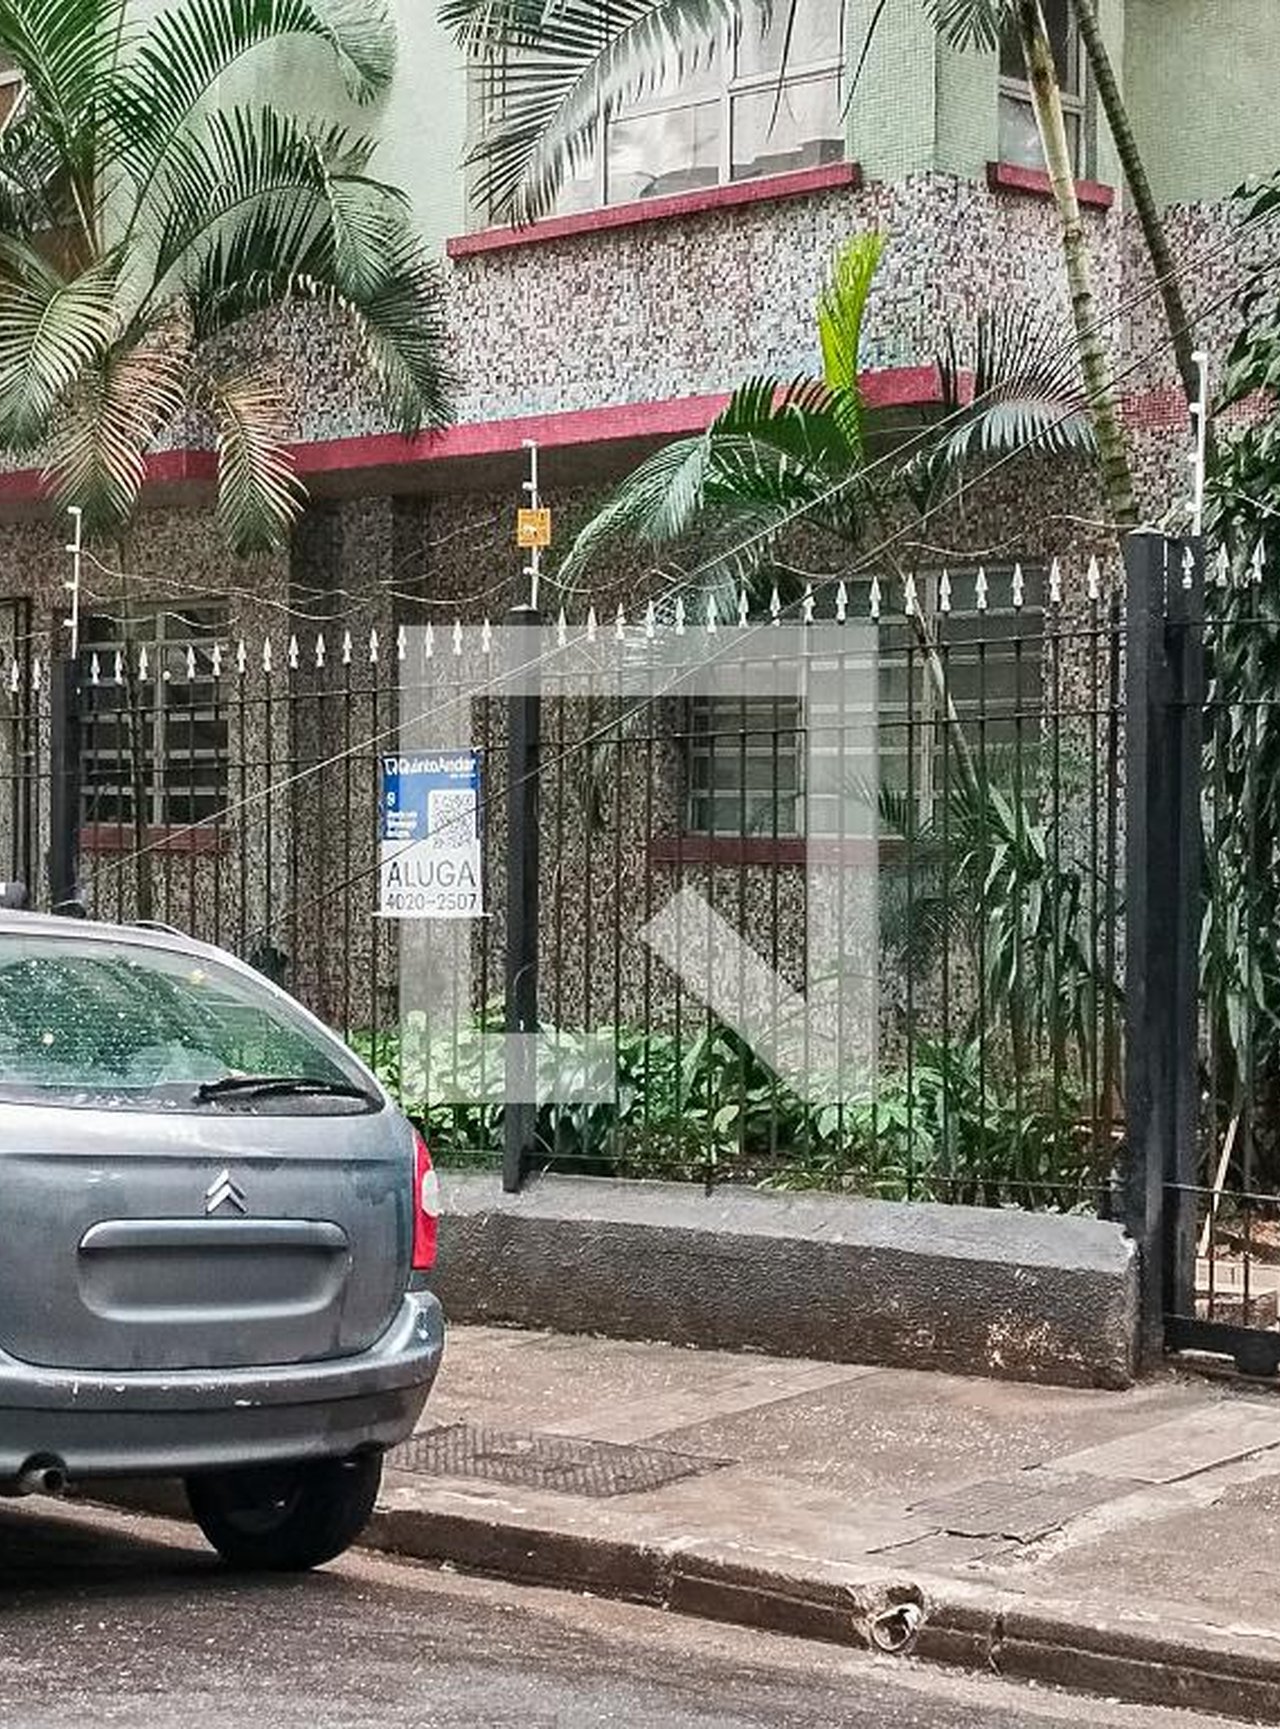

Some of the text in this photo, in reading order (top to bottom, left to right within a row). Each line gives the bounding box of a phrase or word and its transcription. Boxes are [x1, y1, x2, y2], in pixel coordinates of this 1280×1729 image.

[400, 757, 478, 774] QuintoAndar
[387, 861, 475, 888] ALUGA
[386, 893, 476, 911] 4020-2507
